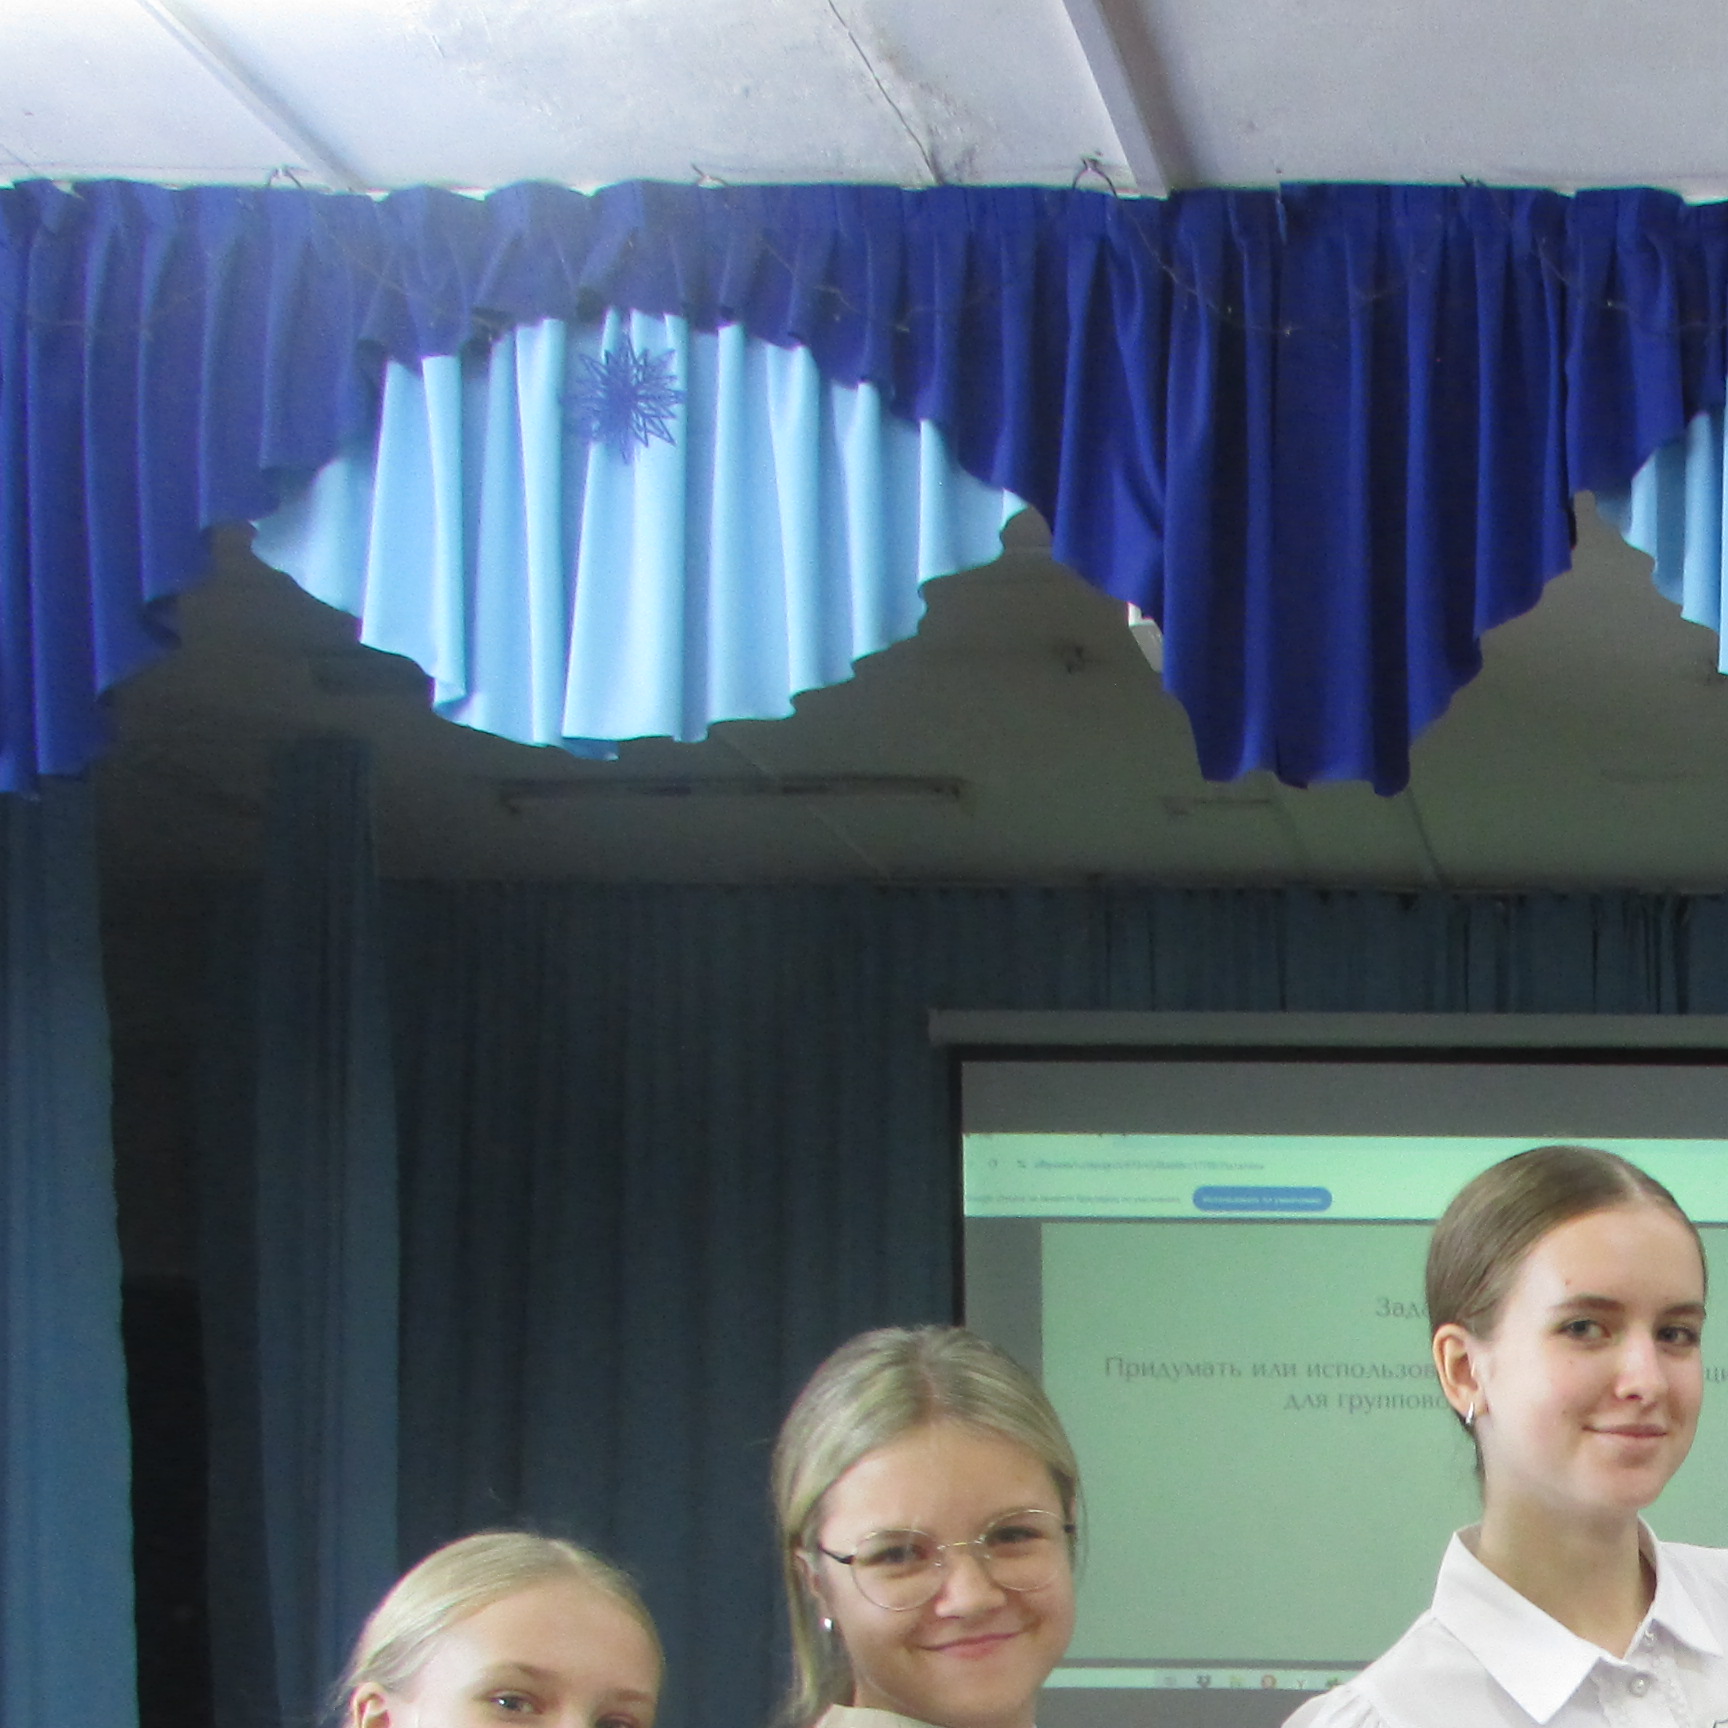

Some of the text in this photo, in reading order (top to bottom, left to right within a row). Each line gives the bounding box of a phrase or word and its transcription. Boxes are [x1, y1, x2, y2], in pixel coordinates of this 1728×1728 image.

[1105, 1357, 1242, 1383] Придумать
[1252, 1362, 1296, 1378] или
[1306, 1362, 1437, 1380] использов
[1283, 1393, 1450, 1414] для группово
